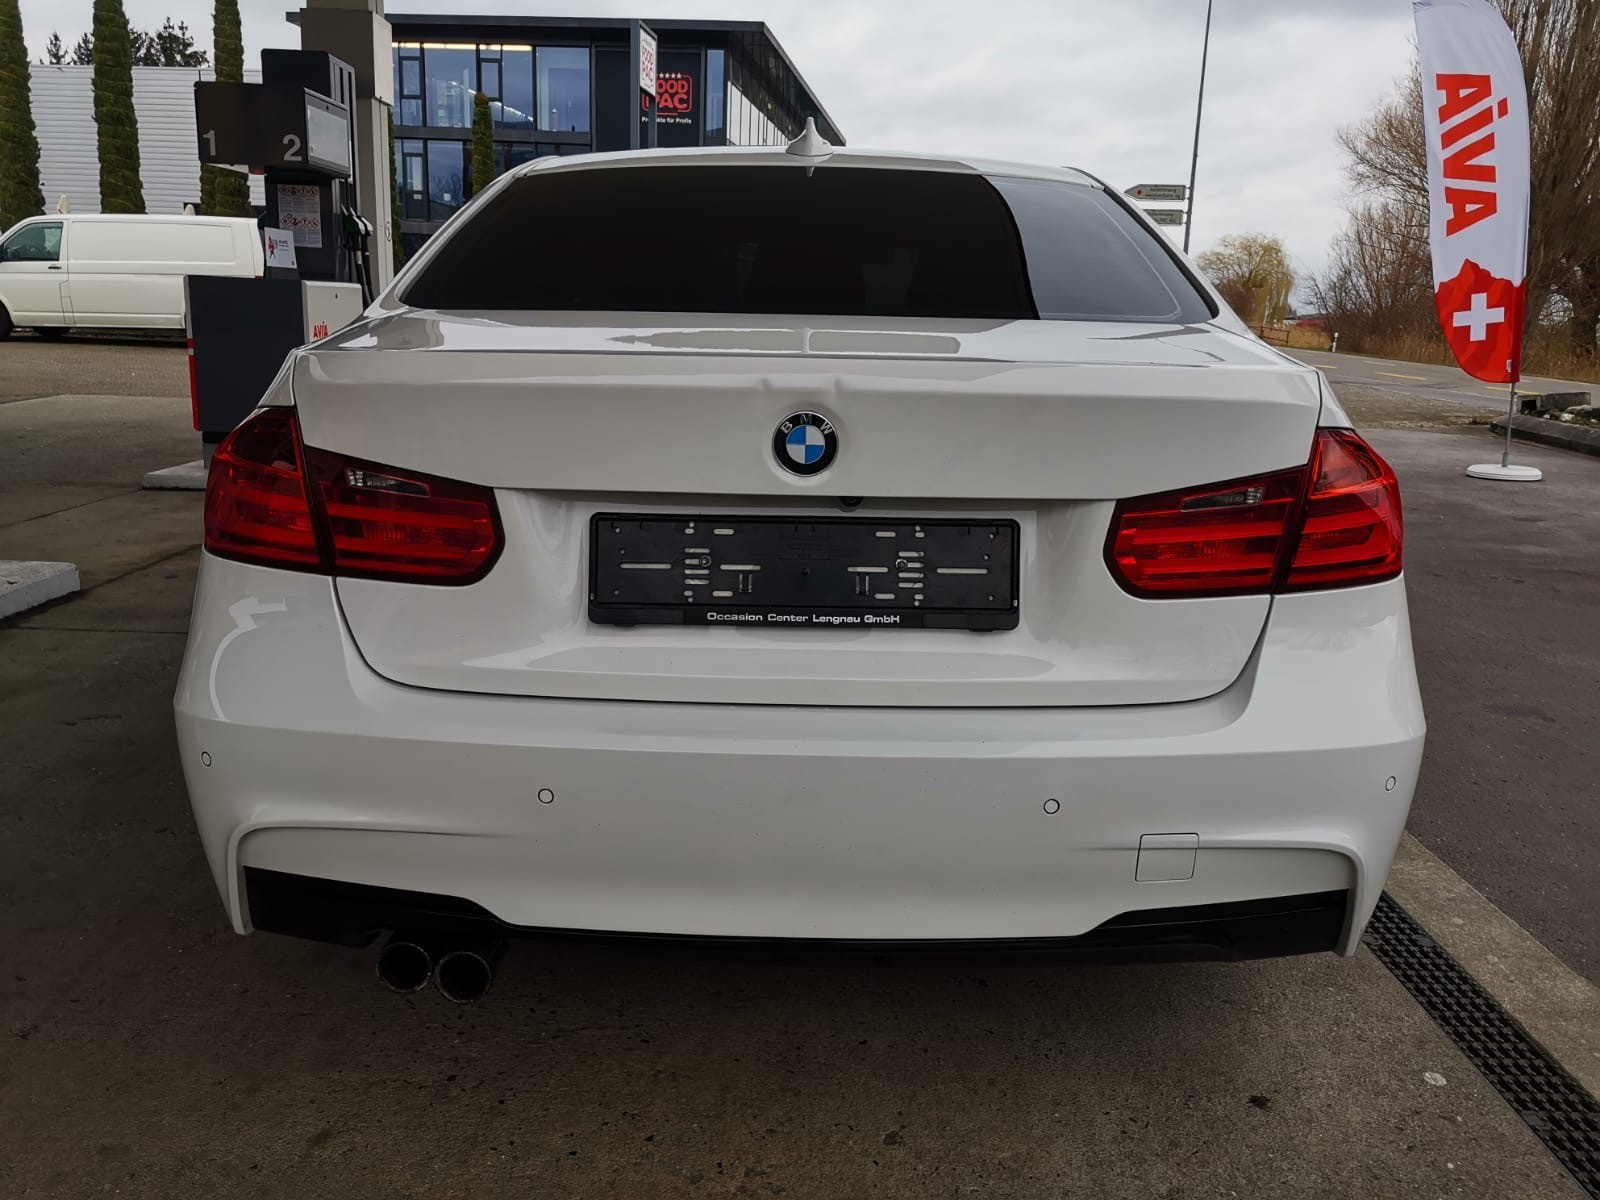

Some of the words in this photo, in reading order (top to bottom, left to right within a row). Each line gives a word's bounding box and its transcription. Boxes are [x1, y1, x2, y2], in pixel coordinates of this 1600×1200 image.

[656, 79, 688, 93] OOD
[202, 130, 216, 156] 1
[282, 134, 302, 161] 2
[780, 413, 833, 434] BMW
[706, 612, 763, 621] Occasion
[767, 613, 808, 622] Center
[812, 614, 861, 624] Lengnau
[864, 614, 900, 623] GmbH
